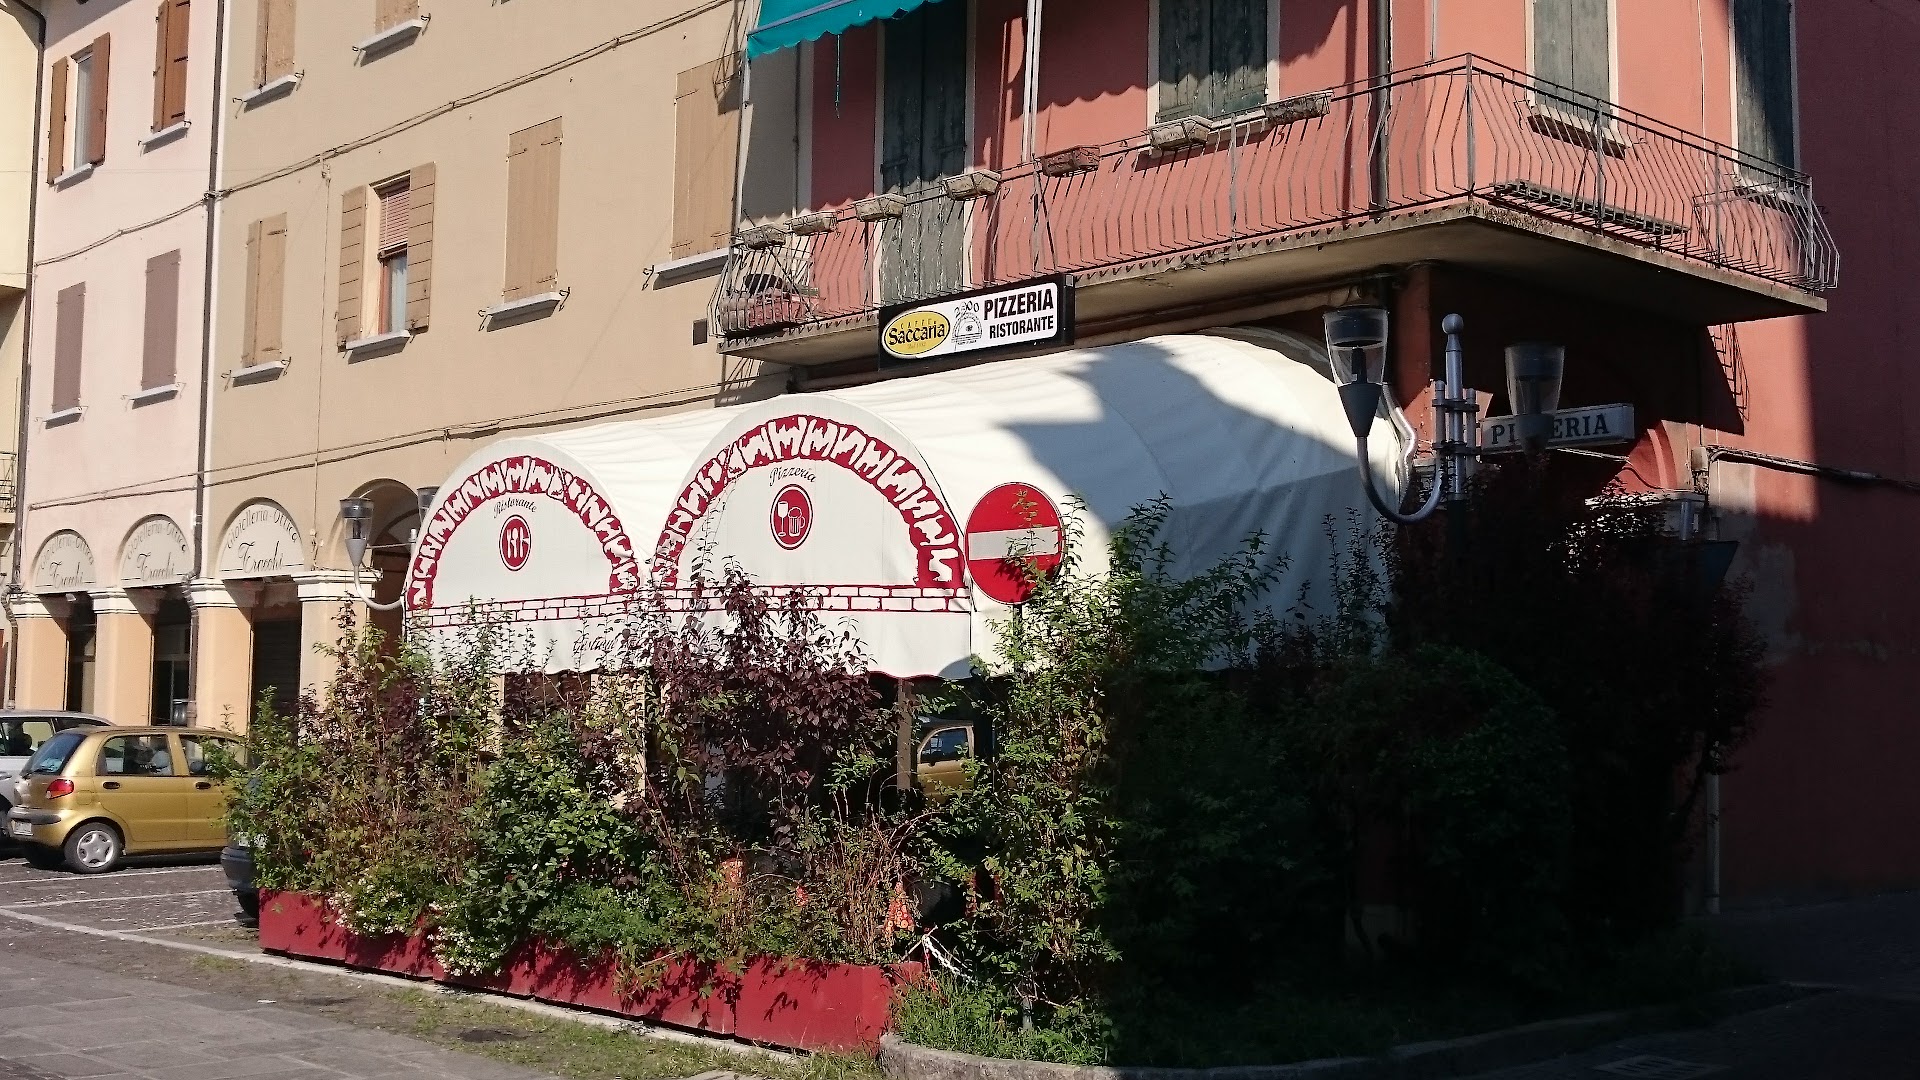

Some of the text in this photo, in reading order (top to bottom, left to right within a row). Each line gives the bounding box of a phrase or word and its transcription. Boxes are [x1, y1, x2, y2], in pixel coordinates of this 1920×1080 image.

[983, 288, 1054, 321] PIZZERIA
[888, 321, 946, 346] Saccaria
[989, 315, 1054, 339] RISTORANTE
[1491, 413, 1610, 445] PIERIA
[769, 466, 816, 487] Pizzeria
[493, 497, 537, 519] Ristorante
